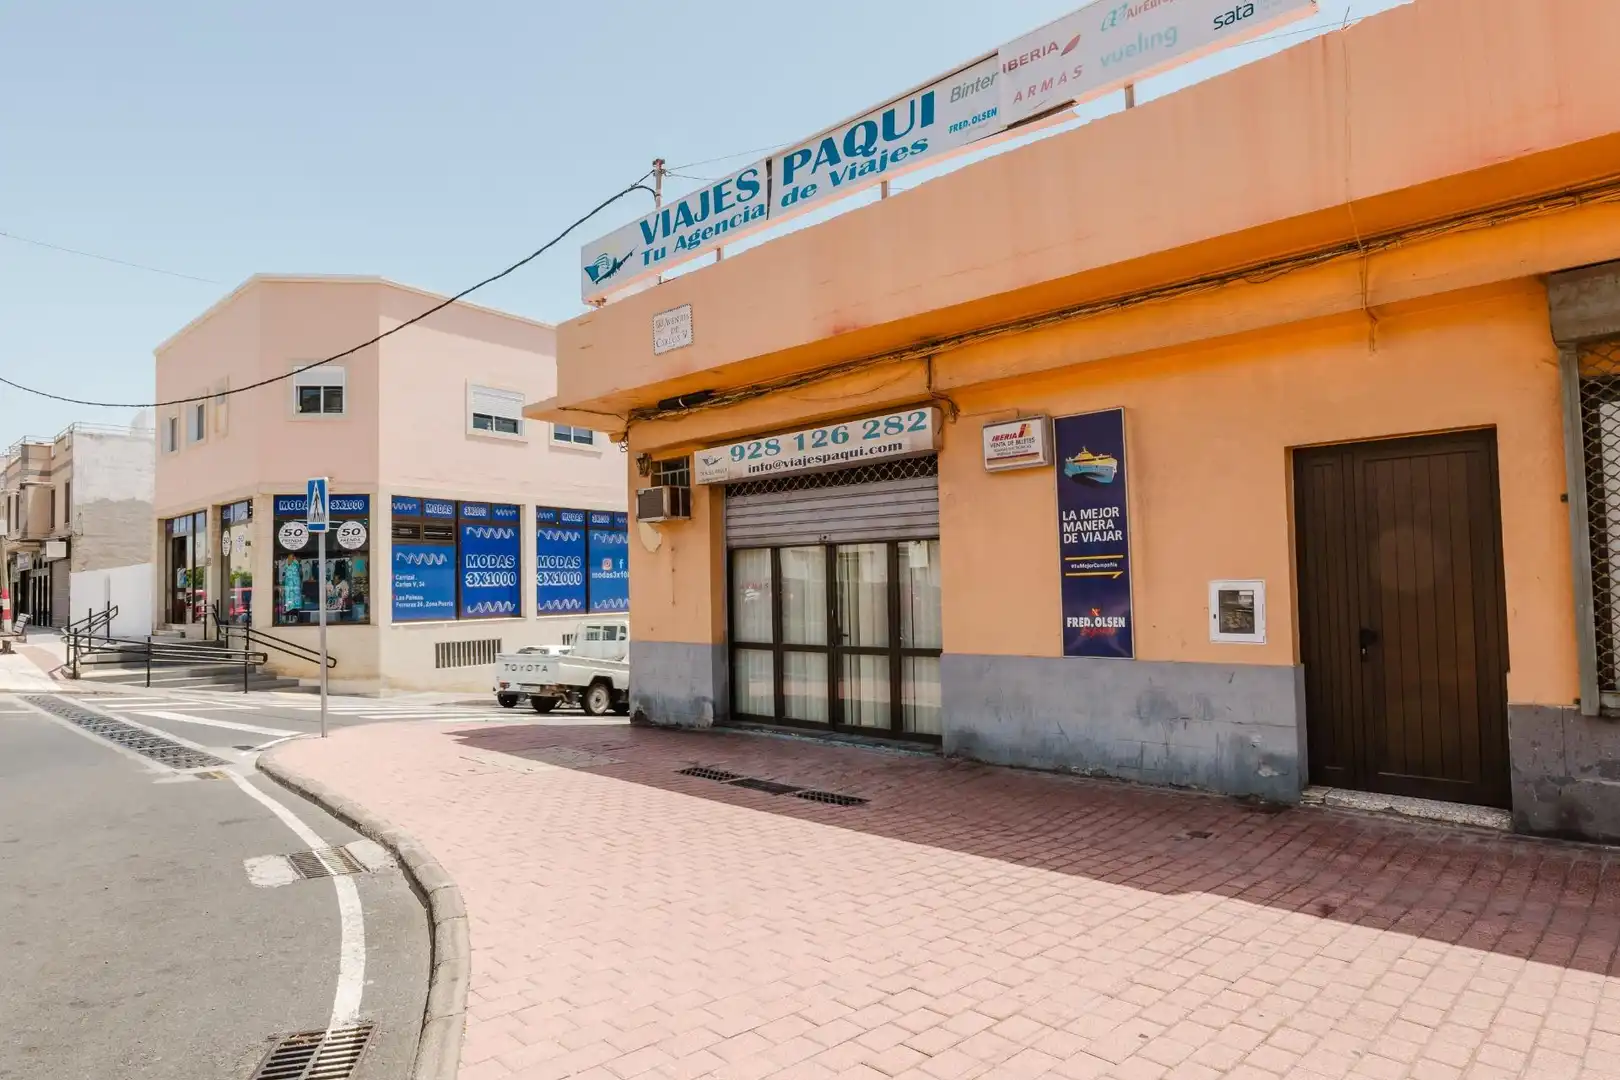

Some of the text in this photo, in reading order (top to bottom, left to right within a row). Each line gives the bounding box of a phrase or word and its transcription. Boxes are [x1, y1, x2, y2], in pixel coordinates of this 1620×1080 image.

[1213, 3, 1254, 30] sata
[1100, 25, 1178, 67] vueling
[1002, 41, 1059, 74] IBERIA
[950, 71, 999, 103] Binter
[1013, 64, 1084, 104] ARMAS
[639, 90, 935, 246] VIAJES PAQUI
[641, 138, 929, 266] Tu Agencia de Viajes
[730, 411, 927, 462] 928 126 282
[991, 433, 1017, 442] IBERIA
[1015, 437, 1036, 445] BILLETES
[748, 441, 903, 474] info@viajespaqui.com
[279, 500, 365, 511] MODA 3X1000
[425, 503, 453, 515] MODAS
[1062, 506, 1120, 521] LA MEJOR
[283, 528, 303, 537] 50
[341, 527, 361, 537] 50
[1063, 518, 1115, 533] MANERA
[1063, 530, 1123, 544] DE VIAJAR
[465, 554, 515, 569] MODAS
[537, 555, 581, 569] MODAS
[465, 571, 517, 588] 3X1000
[536, 571, 582, 586] 3X1000
[591, 571, 630, 579] modas3x10
[504, 663, 549, 673] TOYOTA
